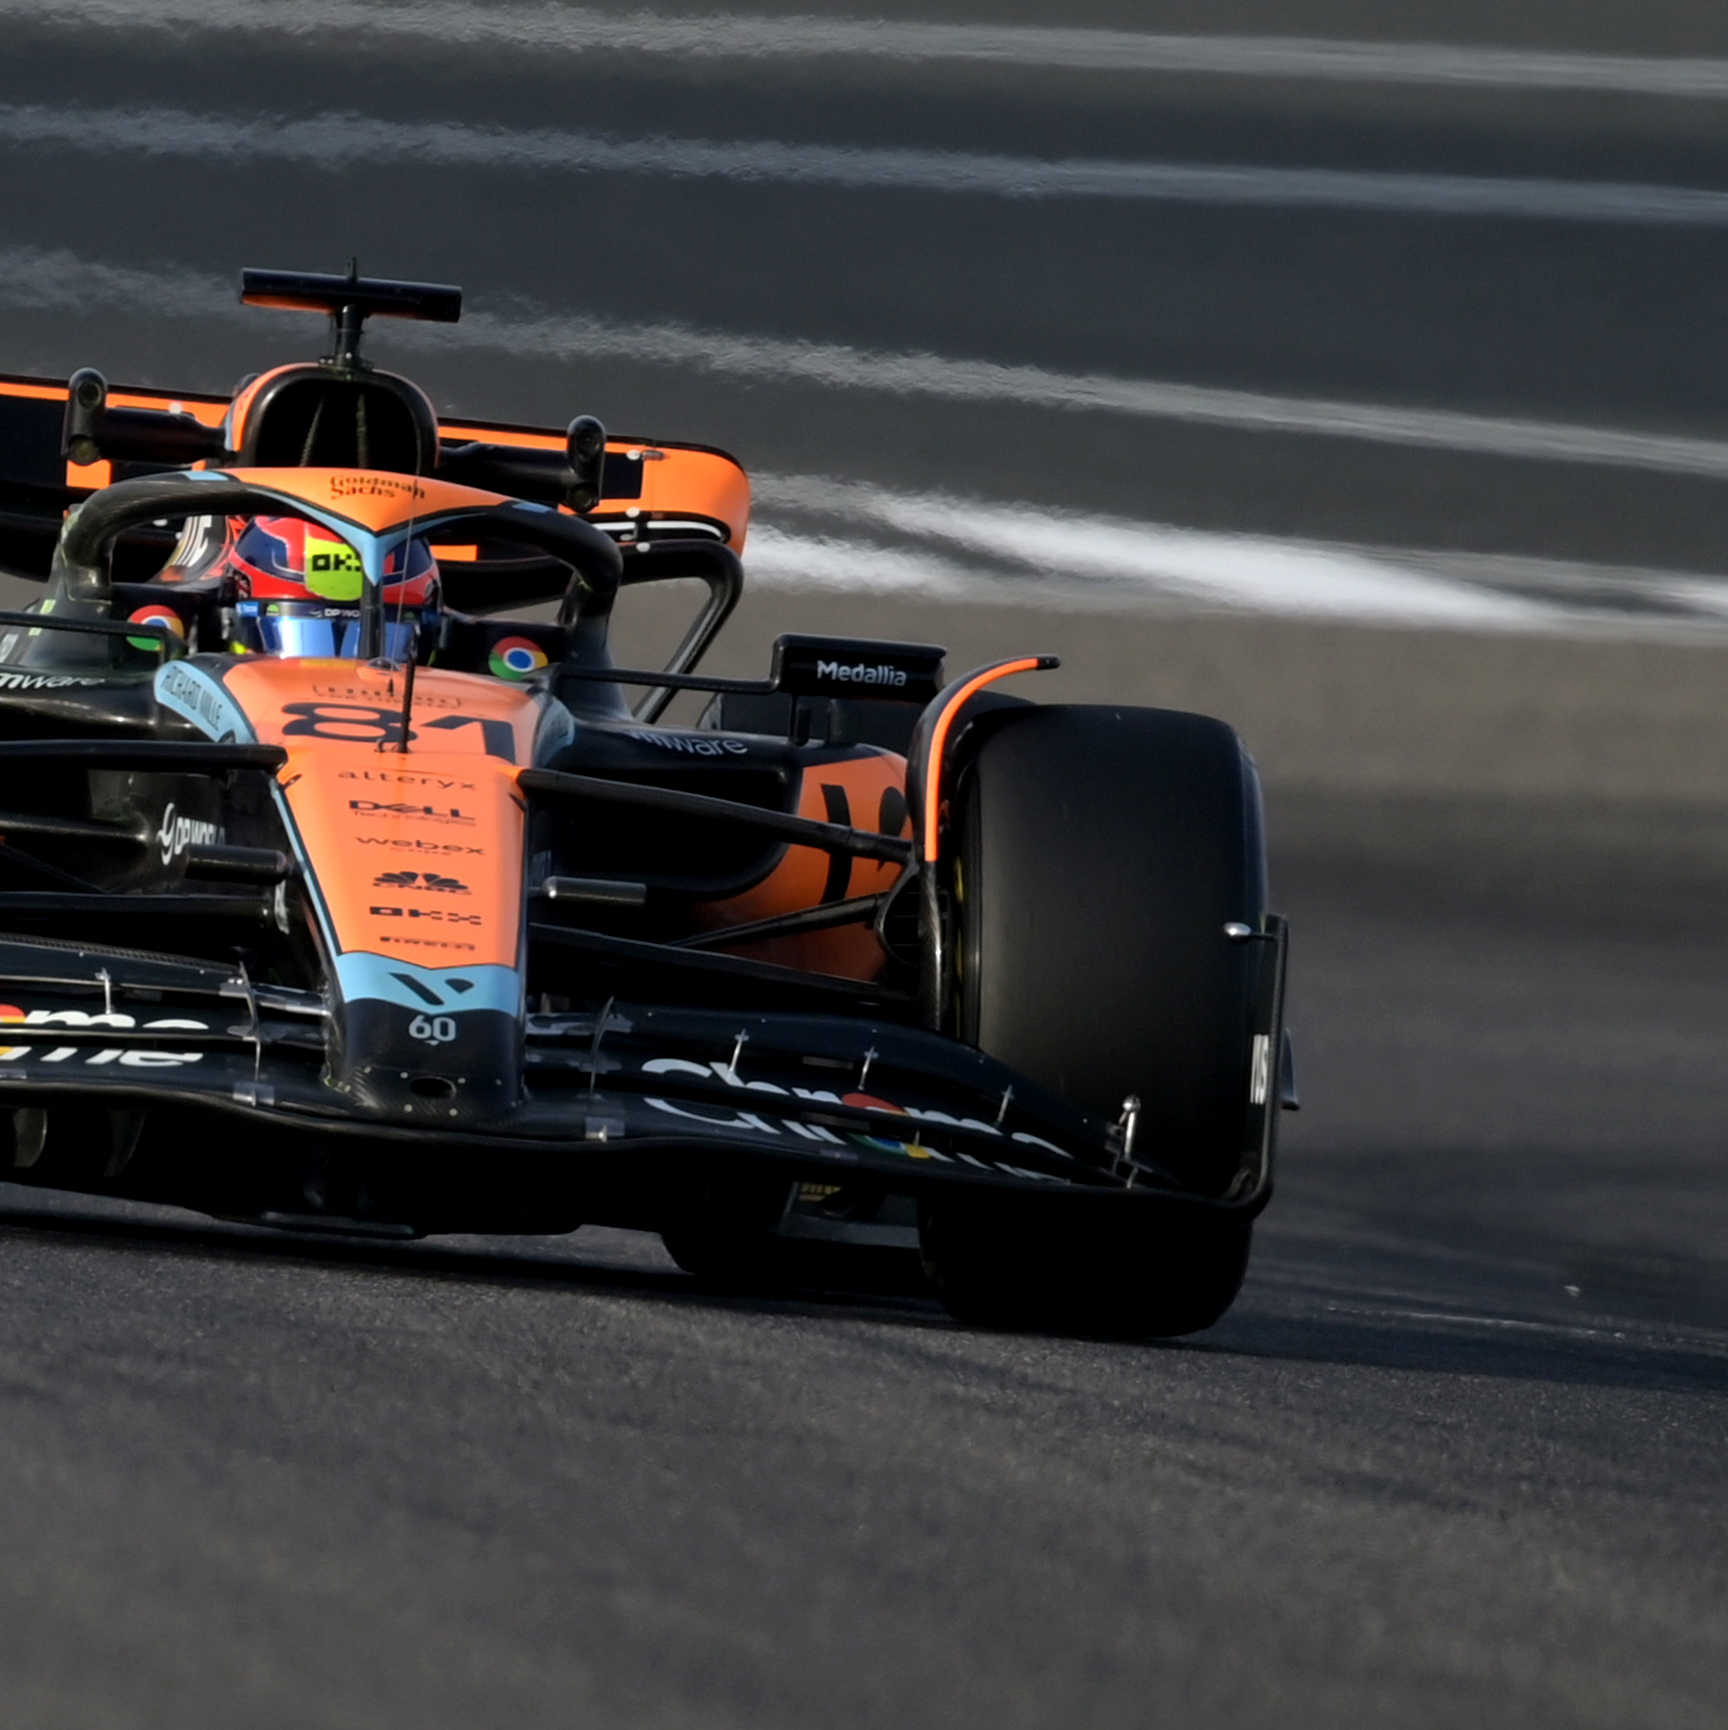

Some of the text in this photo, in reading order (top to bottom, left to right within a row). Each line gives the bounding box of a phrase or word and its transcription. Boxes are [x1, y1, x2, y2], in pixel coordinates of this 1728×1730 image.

[330, 485, 396, 501] Sachs
[816, 660, 907, 687] Medallia
[282, 702, 517, 765] 81
[338, 769, 477, 791] alteryx
[349, 799, 477, 821] DELL
[356, 836, 485, 855] webex
[369, 906, 482, 926] OKX
[408, 1014, 457, 1042] 60
